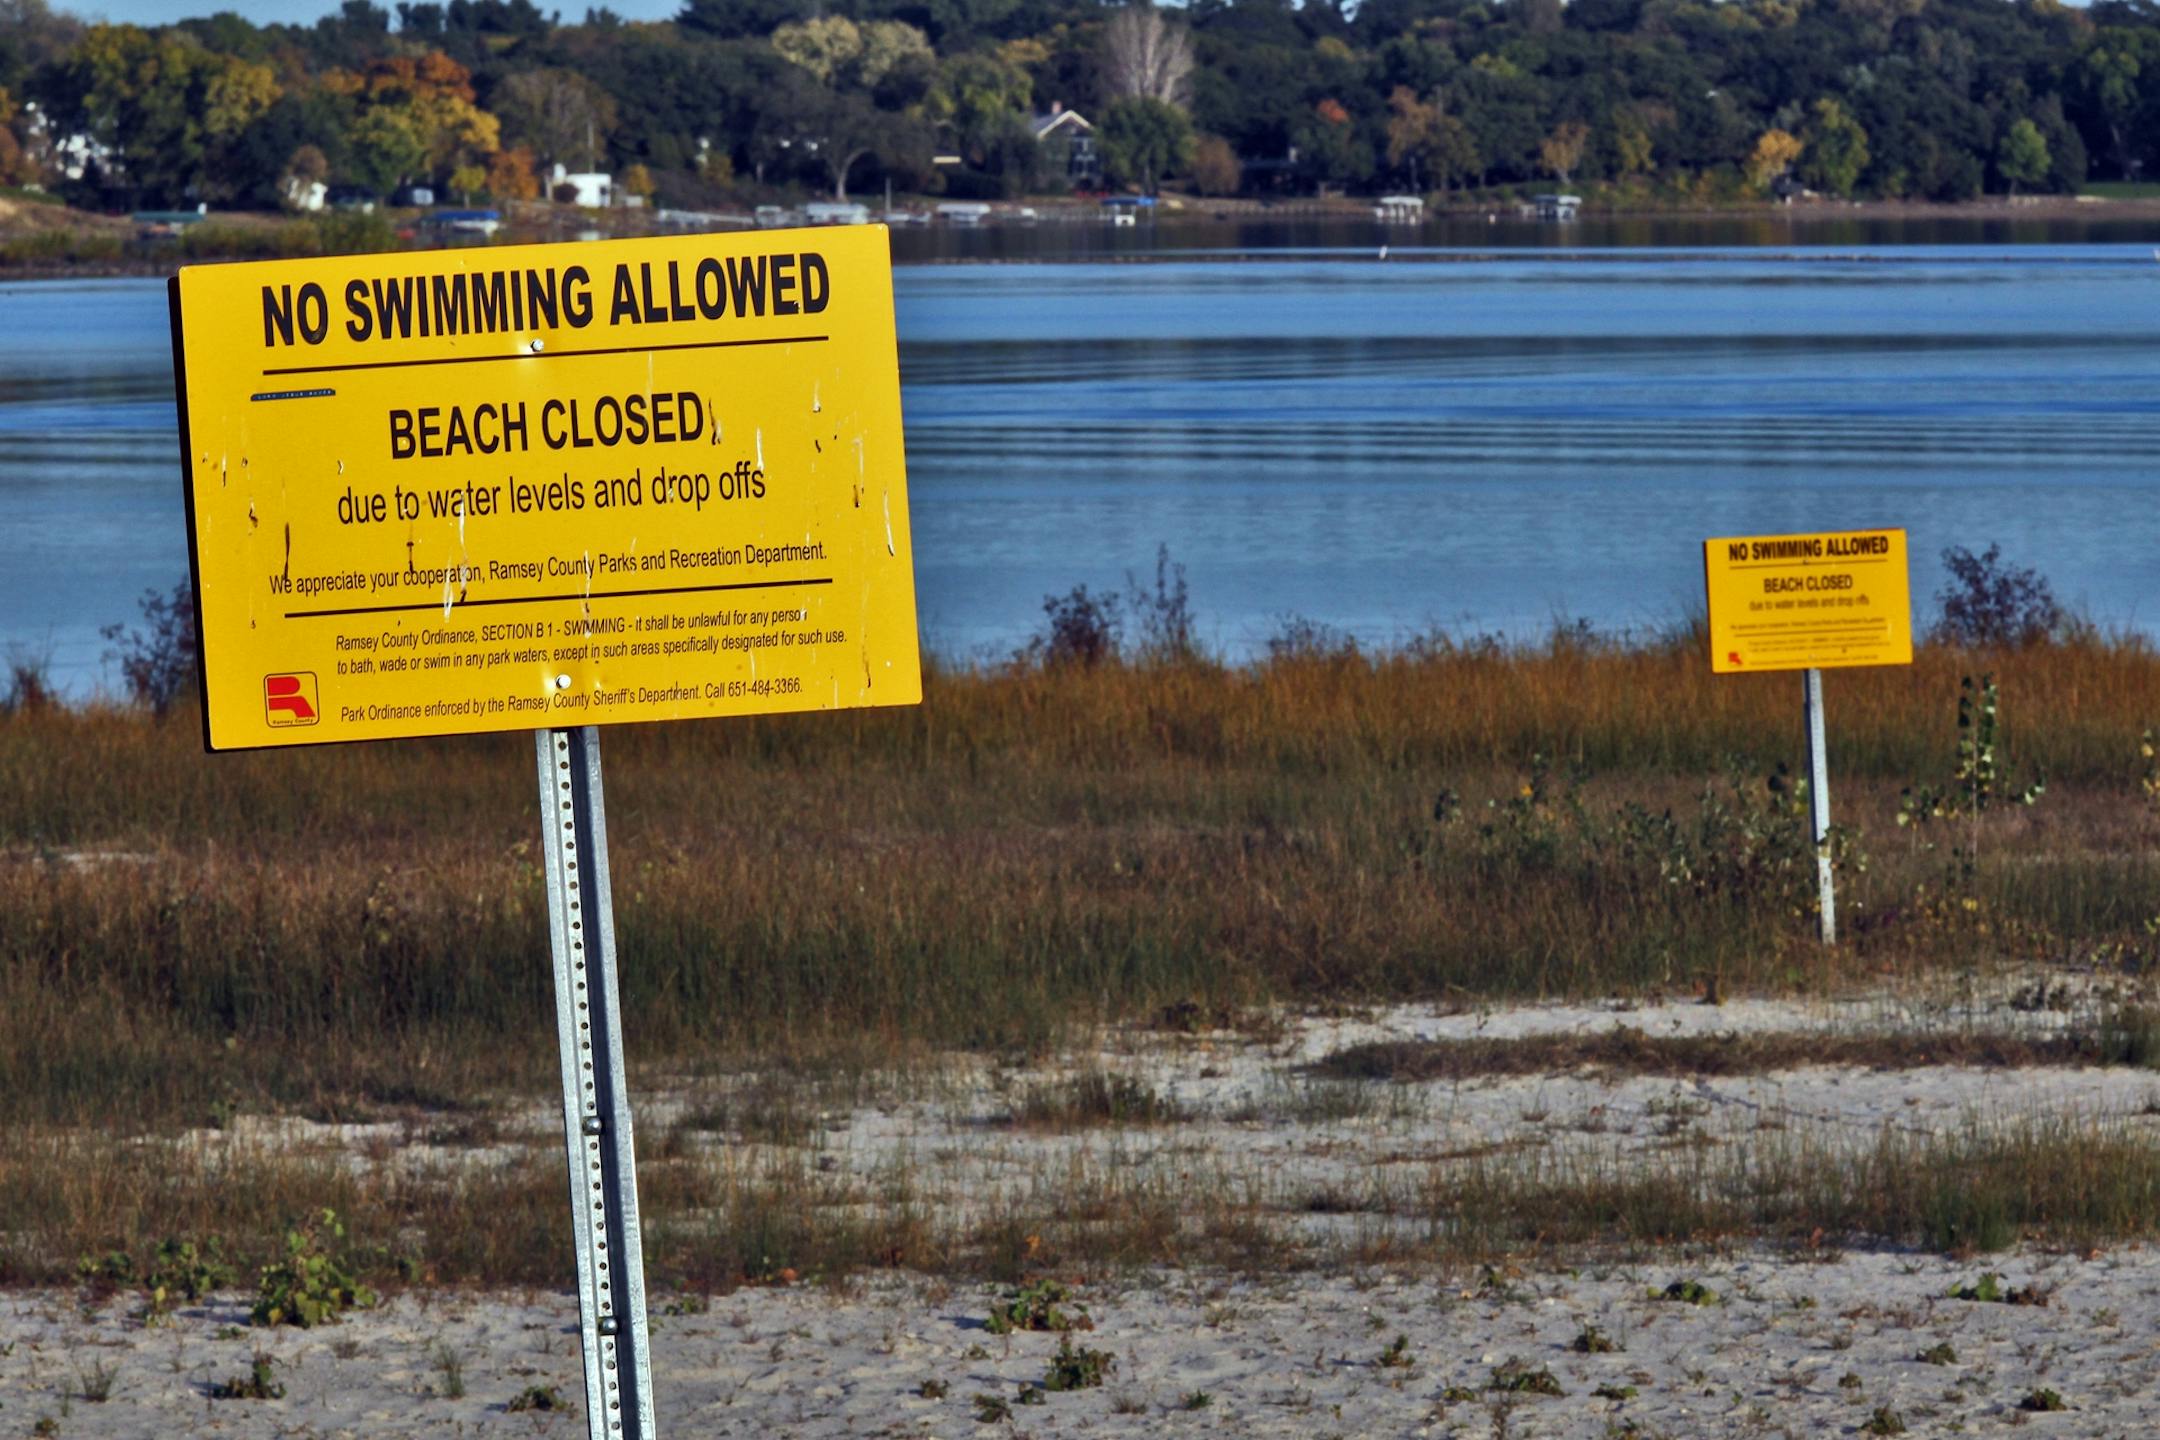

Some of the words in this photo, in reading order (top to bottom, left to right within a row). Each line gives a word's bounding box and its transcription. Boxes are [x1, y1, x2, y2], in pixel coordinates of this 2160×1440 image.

[262, 282, 328, 347] NO
[345, 266, 593, 342] SWIMMING
[610, 253, 829, 325] ALLOWED
[389, 402, 528, 459] BEACH
[542, 392, 703, 449] CLOSED
[338, 486, 386, 524] due
[395, 485, 419, 520] to
[428, 480, 501, 518] water
[510, 473, 585, 513] levels
[594, 468, 642, 508] and
[652, 466, 710, 511] drop
[719, 461, 765, 500] offs
[269, 574, 292, 594] We
[296, 571, 366, 597] appreciate
[370, 572, 399, 593] your
[403, 564, 485, 588] cooperaton,
[489, 561, 543, 582] Ramsey
[548, 556, 594, 579] County
[599, 553, 637, 573] Parks
[641, 550, 666, 570] and
[670, 546, 741, 568] Recreation
[745, 541, 827, 567] Department.
[1729, 543, 1748, 561] NO
[1752, 539, 1822, 560] SWIMMING
[1826, 536, 1888, 556] ALLOWED
[1764, 577, 1803, 593] BEACH
[1806, 575, 1853, 591] CLOSED
[336, 635, 379, 652] Ramsey
[382, 632, 419, 650] County
[422, 629, 478, 646] Ordinance,
[481, 624, 533, 641] SECTION
[536, 622, 544, 637] B
[547, 622, 553, 637] 1
[563, 617, 625, 636] SWIMMING
[645, 615, 669, 631] shall
[672, 614, 685, 629] be
[688, 611, 731, 628] unlawful
[733, 610, 748, 625] for
[750, 611, 769, 627] any
[337, 660, 348, 675] to
[350, 658, 376, 674] bath,
[380, 656, 407, 671] wade
[410, 657, 421, 670] or
[423, 653, 450, 669] swim
[453, 652, 462, 667] in
[465, 653, 485, 669] any
[487, 648, 511, 668] park
[513, 648, 550, 663] waters,
[553, 644, 588, 662] except
[591, 643, 600, 658] in
[603, 641, 628, 657] such
[631, 642, 660, 656] areas
[663, 636, 719, 658] specifically
[721, 632, 778, 652] designated
[781, 630, 795, 645] for
[798, 629, 822, 645] such
[825, 630, 847, 643] use.
[341, 706, 365, 721] Park
[368, 704, 421, 721] Ordinance
[424, 699, 470, 716] enforced
[473, 698, 486, 717] by
[488, 697, 505, 712] the
[508, 695, 550, 712] Ramsey
[553, 692, 590, 710] County
[593, 688, 635, 705] Sheriff's
[638, 685, 702, 704] Department.
[705, 682, 725, 699] Call
[728, 677, 803, 697] 651-484-3366.
